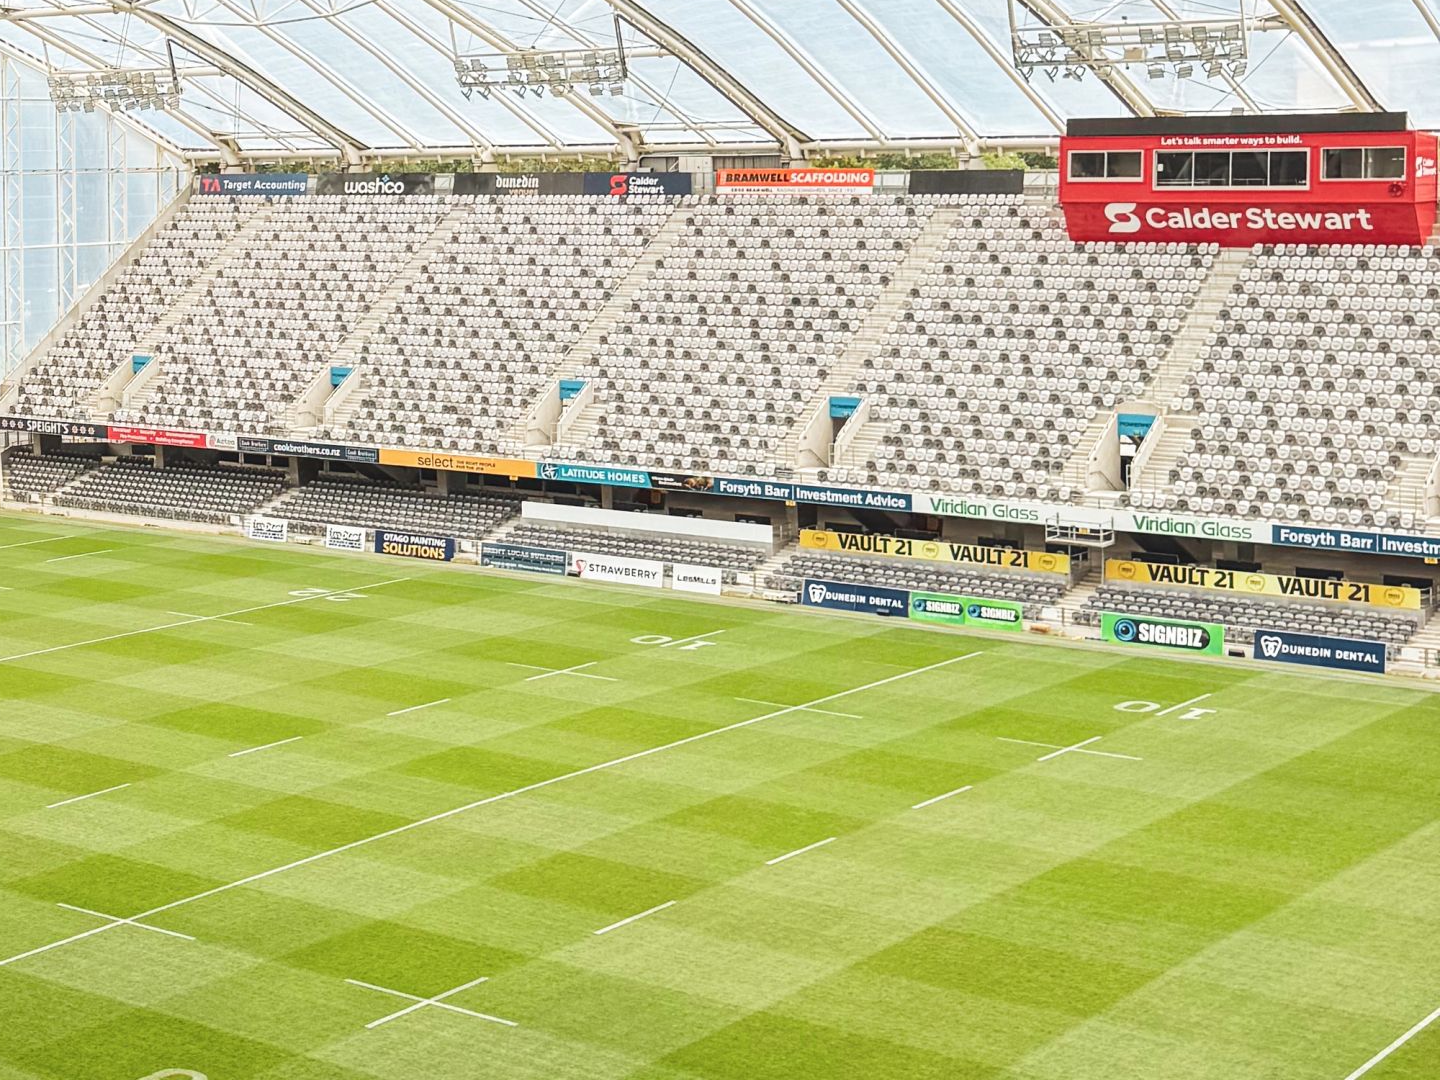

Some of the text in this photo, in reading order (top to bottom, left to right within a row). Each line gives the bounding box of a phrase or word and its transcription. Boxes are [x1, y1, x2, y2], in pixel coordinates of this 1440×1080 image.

[1161, 135, 1302, 146] Let's talk smarter ways to build.
[223, 179, 251, 190] Target
[254, 180, 306, 191] Accounting
[345, 177, 404, 195] washco
[495, 174, 539, 188] dunedin
[629, 176, 659, 186] Calder
[726, 172, 789, 183] BRAMWELL
[790, 172, 870, 184] SCAFFOLDING
[628, 185, 664, 194] Stewart
[1145, 208, 1373, 230] Calder Stewart
[273, 443, 340, 456] cookbrothers.co.nz
[418, 453, 454, 468] select
[561, 467, 605, 480] LATITUDE
[607, 471, 645, 483] HOMES
[719, 481, 906, 508] Forsyth Barr Investment Advice
[929, 497, 1039, 521] Viridian Glass
[1132, 514, 1253, 540] Viridian Glass
[383, 533, 446, 547] OTAGO PAINTING
[838, 533, 913, 556] VAULT 21
[1280, 528, 1337, 550] Forsyth
[1340, 533, 1373, 550] Barr
[383, 542, 445, 559] SOLUTIONS
[950, 544, 1029, 568] VAULT 21
[589, 563, 657, 580] STRAWBERRY
[1147, 564, 1234, 589] VAULT 21
[1277, 576, 1370, 603] VAULT 21
[826, 591, 904, 609] DUNEDIN DENTAL
[926, 600, 960, 615] SIGNBIZ
[980, 606, 1016, 622] SIGNBIZ
[1138, 622, 1203, 648] SIGNBIZ
[1281, 644, 1379, 664] DUNEDIN DENTAL
